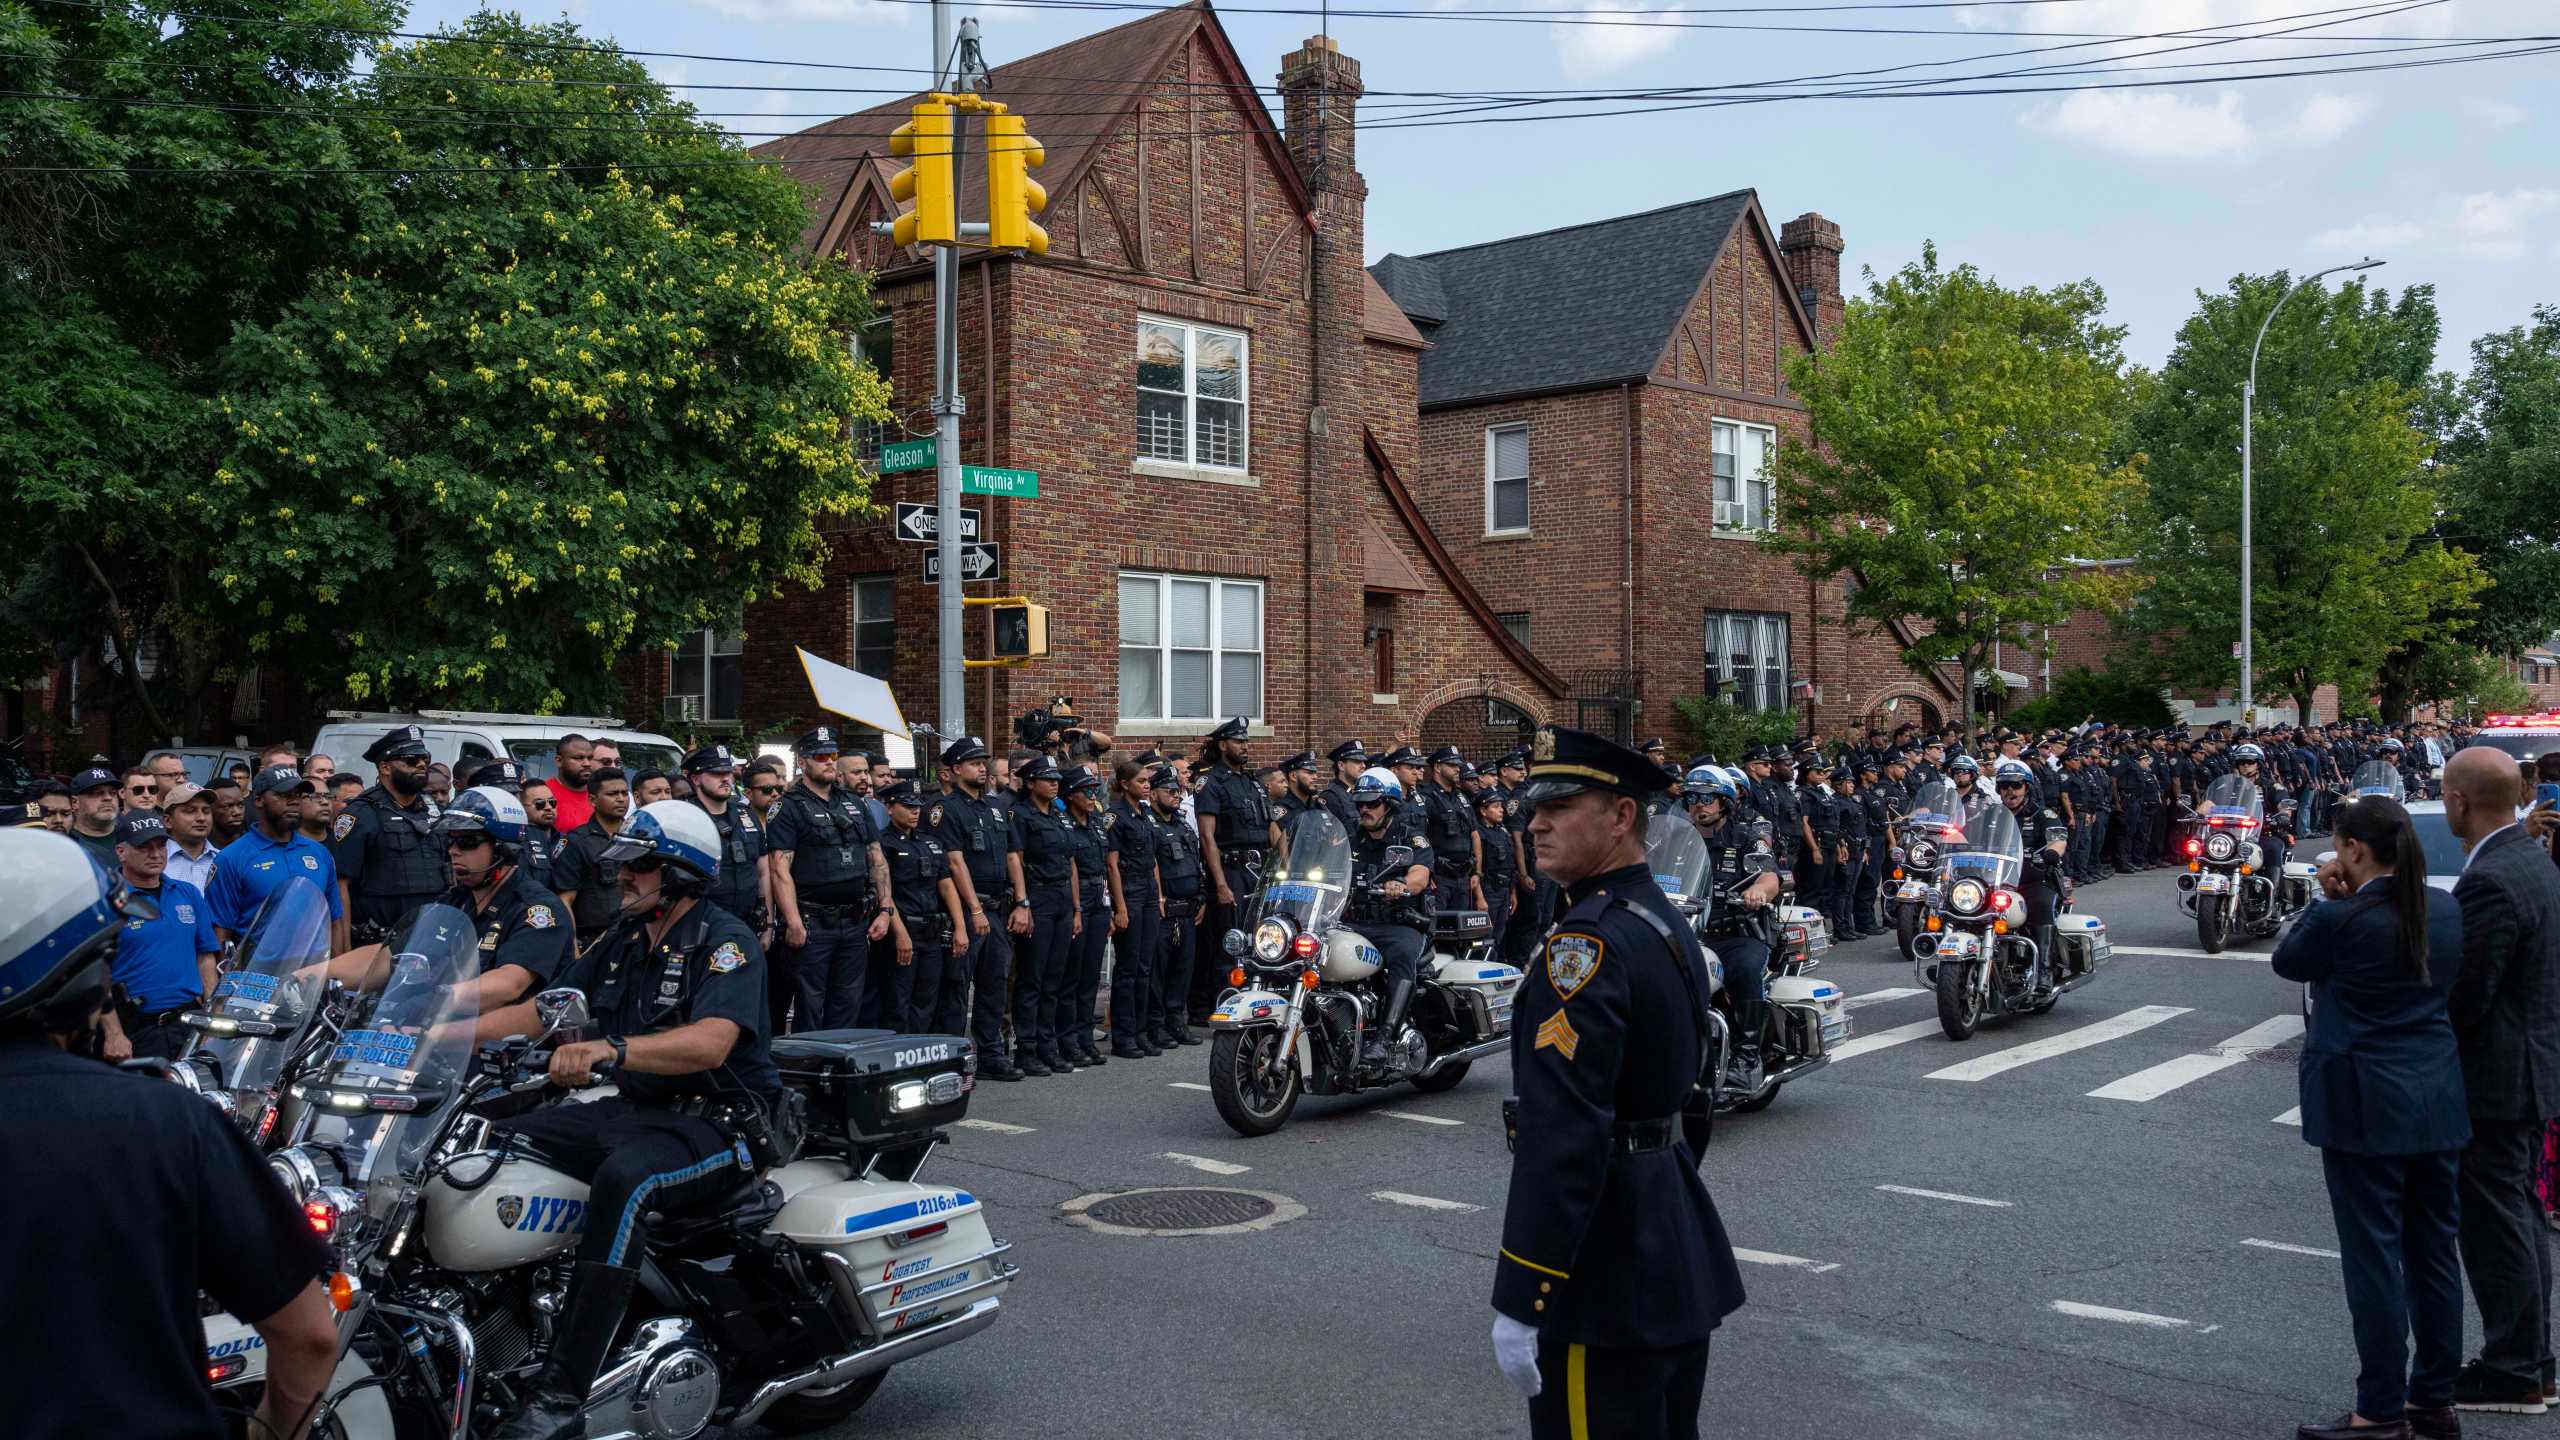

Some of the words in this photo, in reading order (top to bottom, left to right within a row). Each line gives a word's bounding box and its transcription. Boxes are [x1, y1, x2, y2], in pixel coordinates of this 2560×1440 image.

[884, 449, 923, 469] Gleason
[927, 444, 935, 455] Av
[973, 470, 1013, 494] Virginia
[1017, 474, 1025, 485] Av
[914, 516, 936, 531] ONE
[962, 556, 983, 569] WAY
[1467, 916, 1487, 927] POLICE
[894, 1043, 949, 1068] POLICE
[882, 1257, 933, 1281] COURTESY
[888, 1269, 971, 1306] PROFESSIONALISM
[207, 1336, 265, 1357] POLIC
